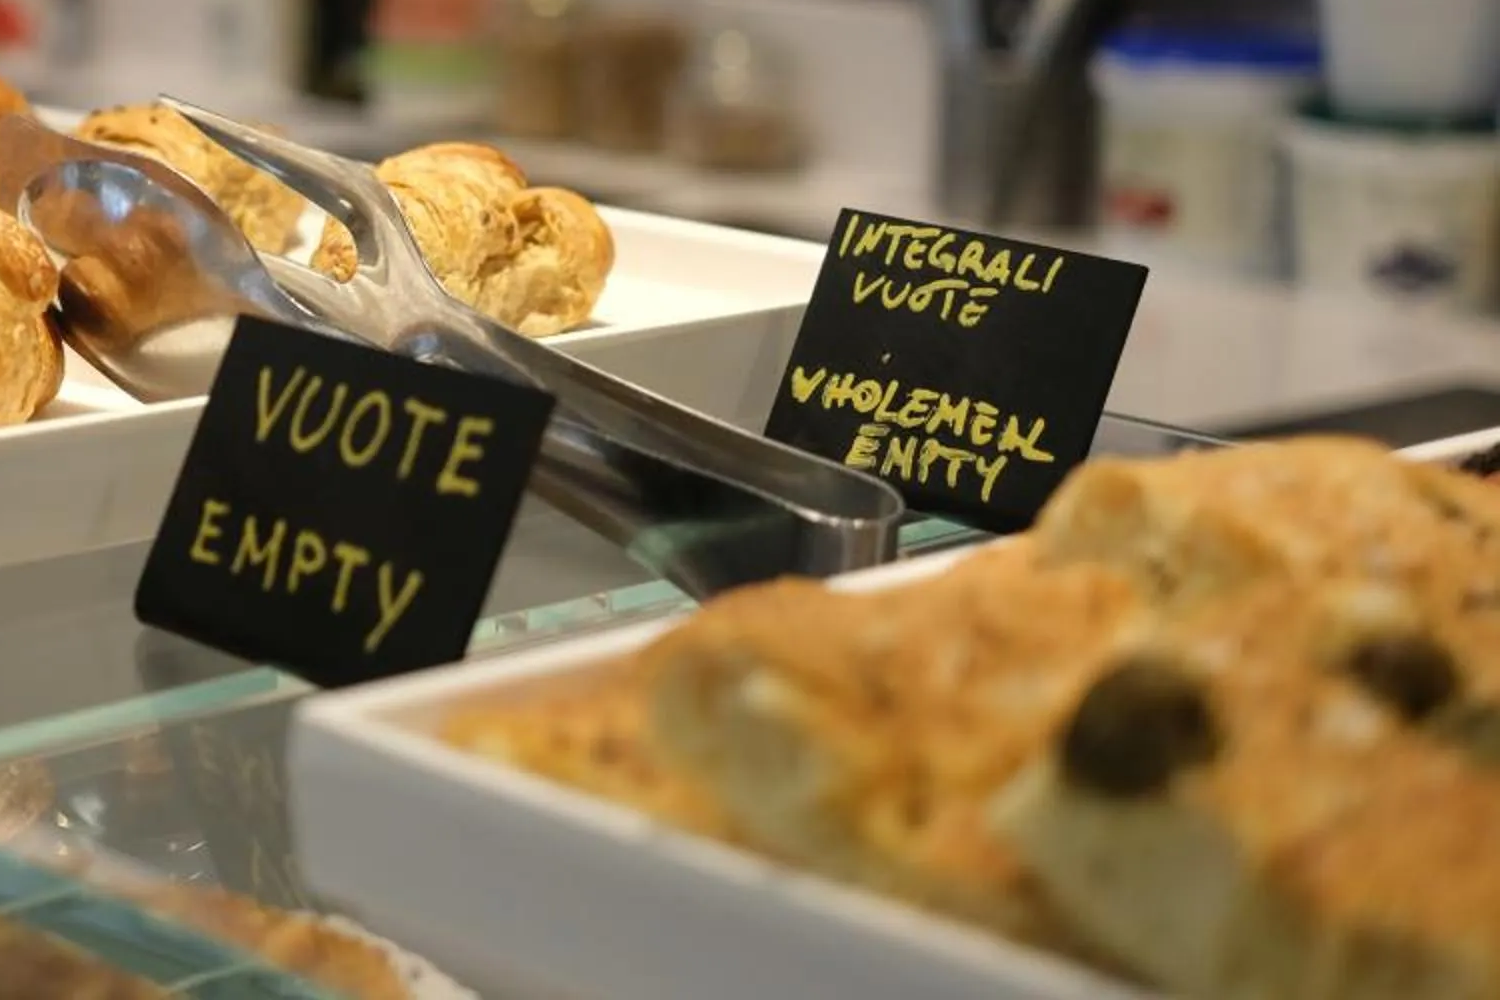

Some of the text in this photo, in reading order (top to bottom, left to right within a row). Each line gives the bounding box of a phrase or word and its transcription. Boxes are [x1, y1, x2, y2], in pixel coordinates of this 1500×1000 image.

[838, 214, 1063, 293] INTEGRALI
[852, 271, 998, 328] VUOTE
[255, 366, 494, 496] VUOTE
[189, 498, 423, 652] EMPTY
